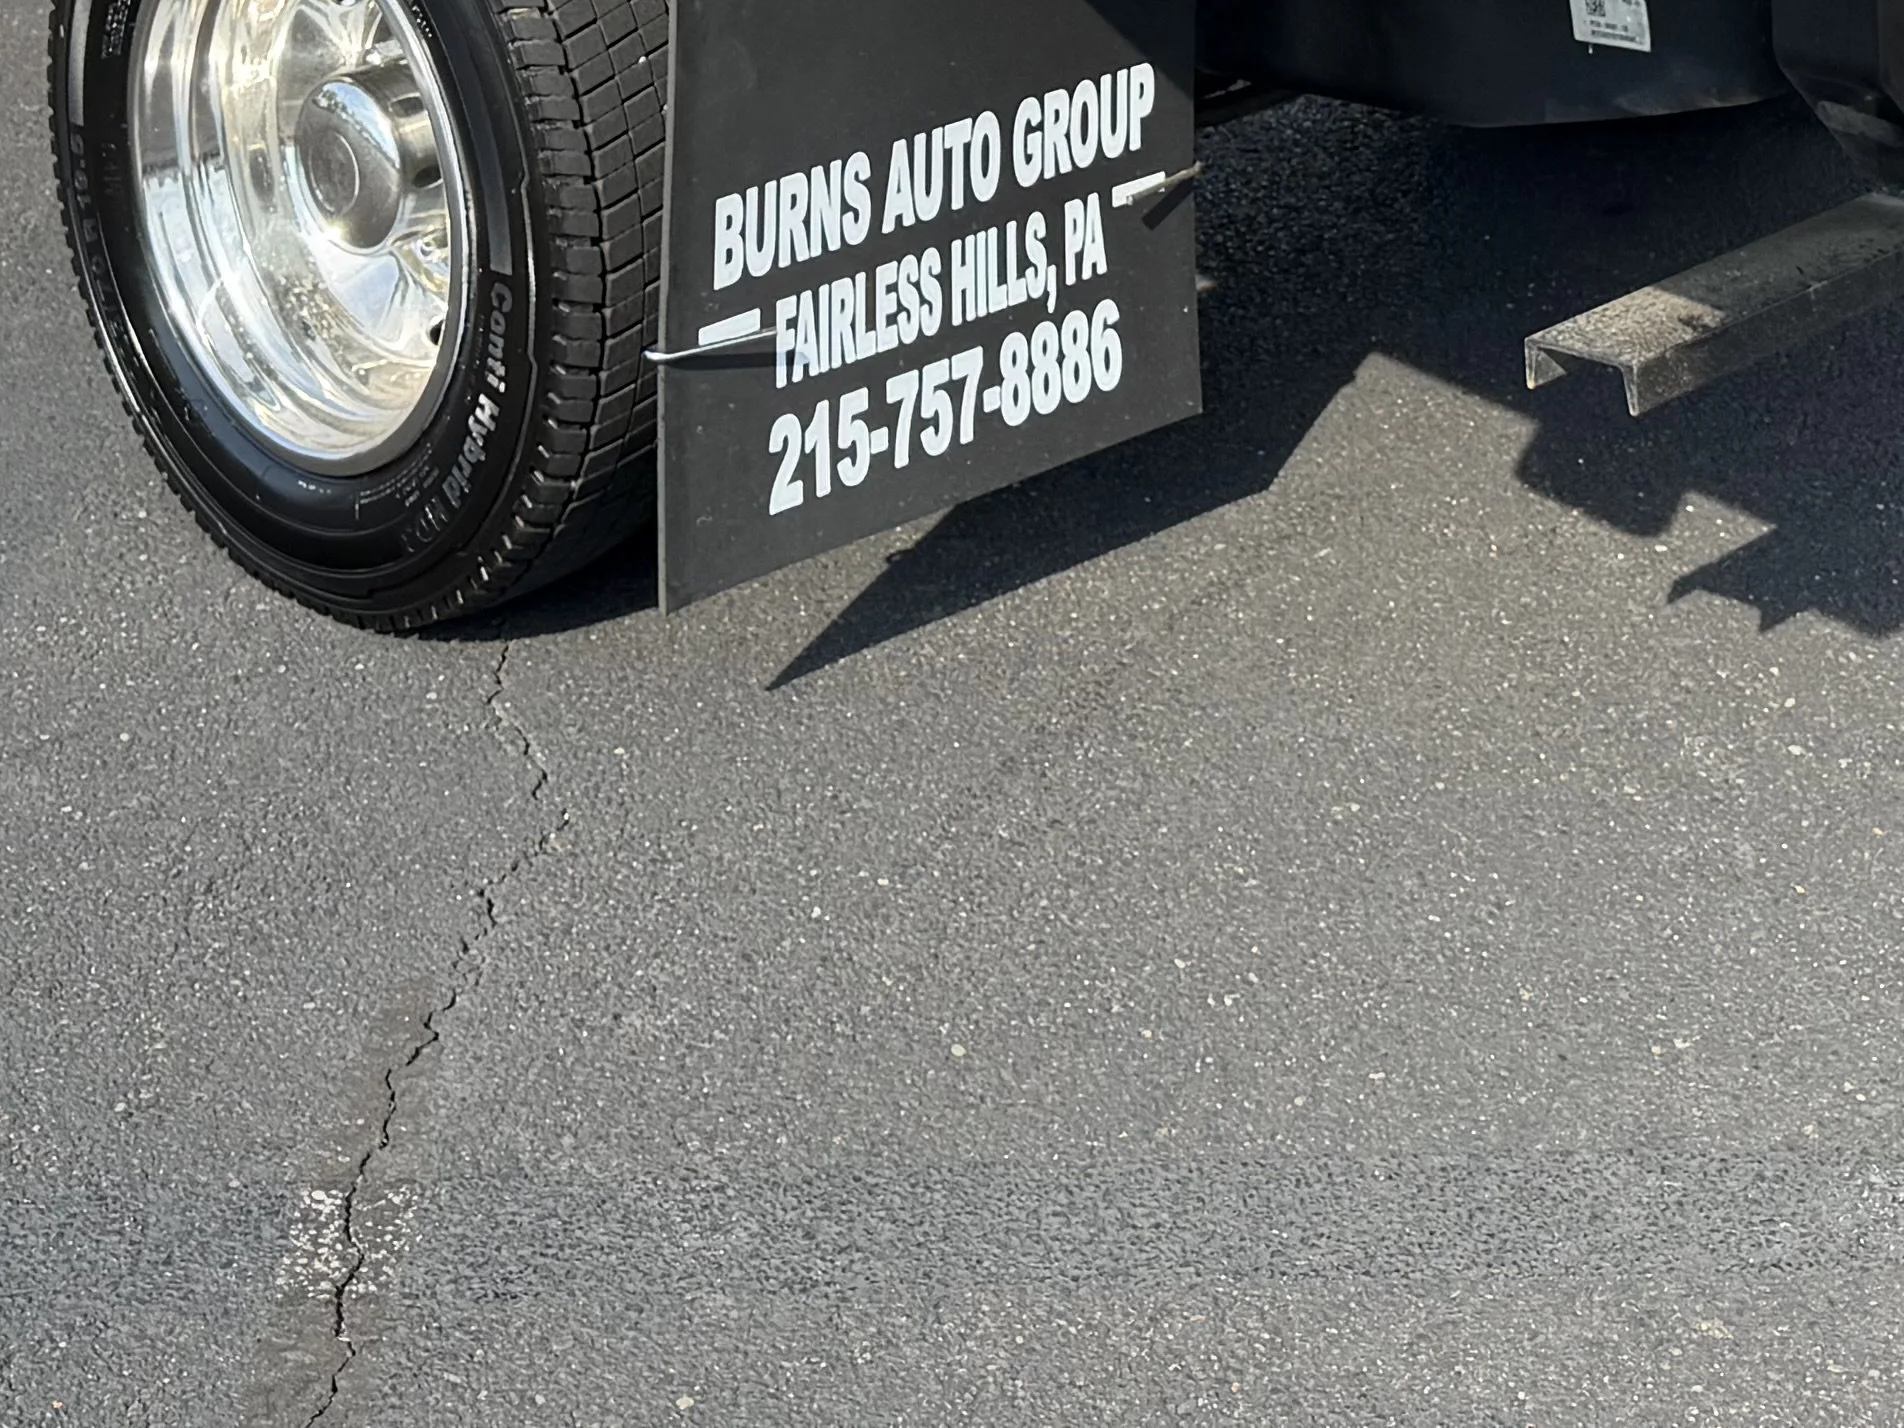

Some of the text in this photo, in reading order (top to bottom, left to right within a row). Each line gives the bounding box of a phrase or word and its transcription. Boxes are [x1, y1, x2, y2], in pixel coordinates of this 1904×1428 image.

[712, 62, 1156, 291] BURNS AUTO GROUP
[775, 192, 1108, 389] FAIRLESS HILLS, PA
[768, 297, 1123, 517] 215-757-8886
